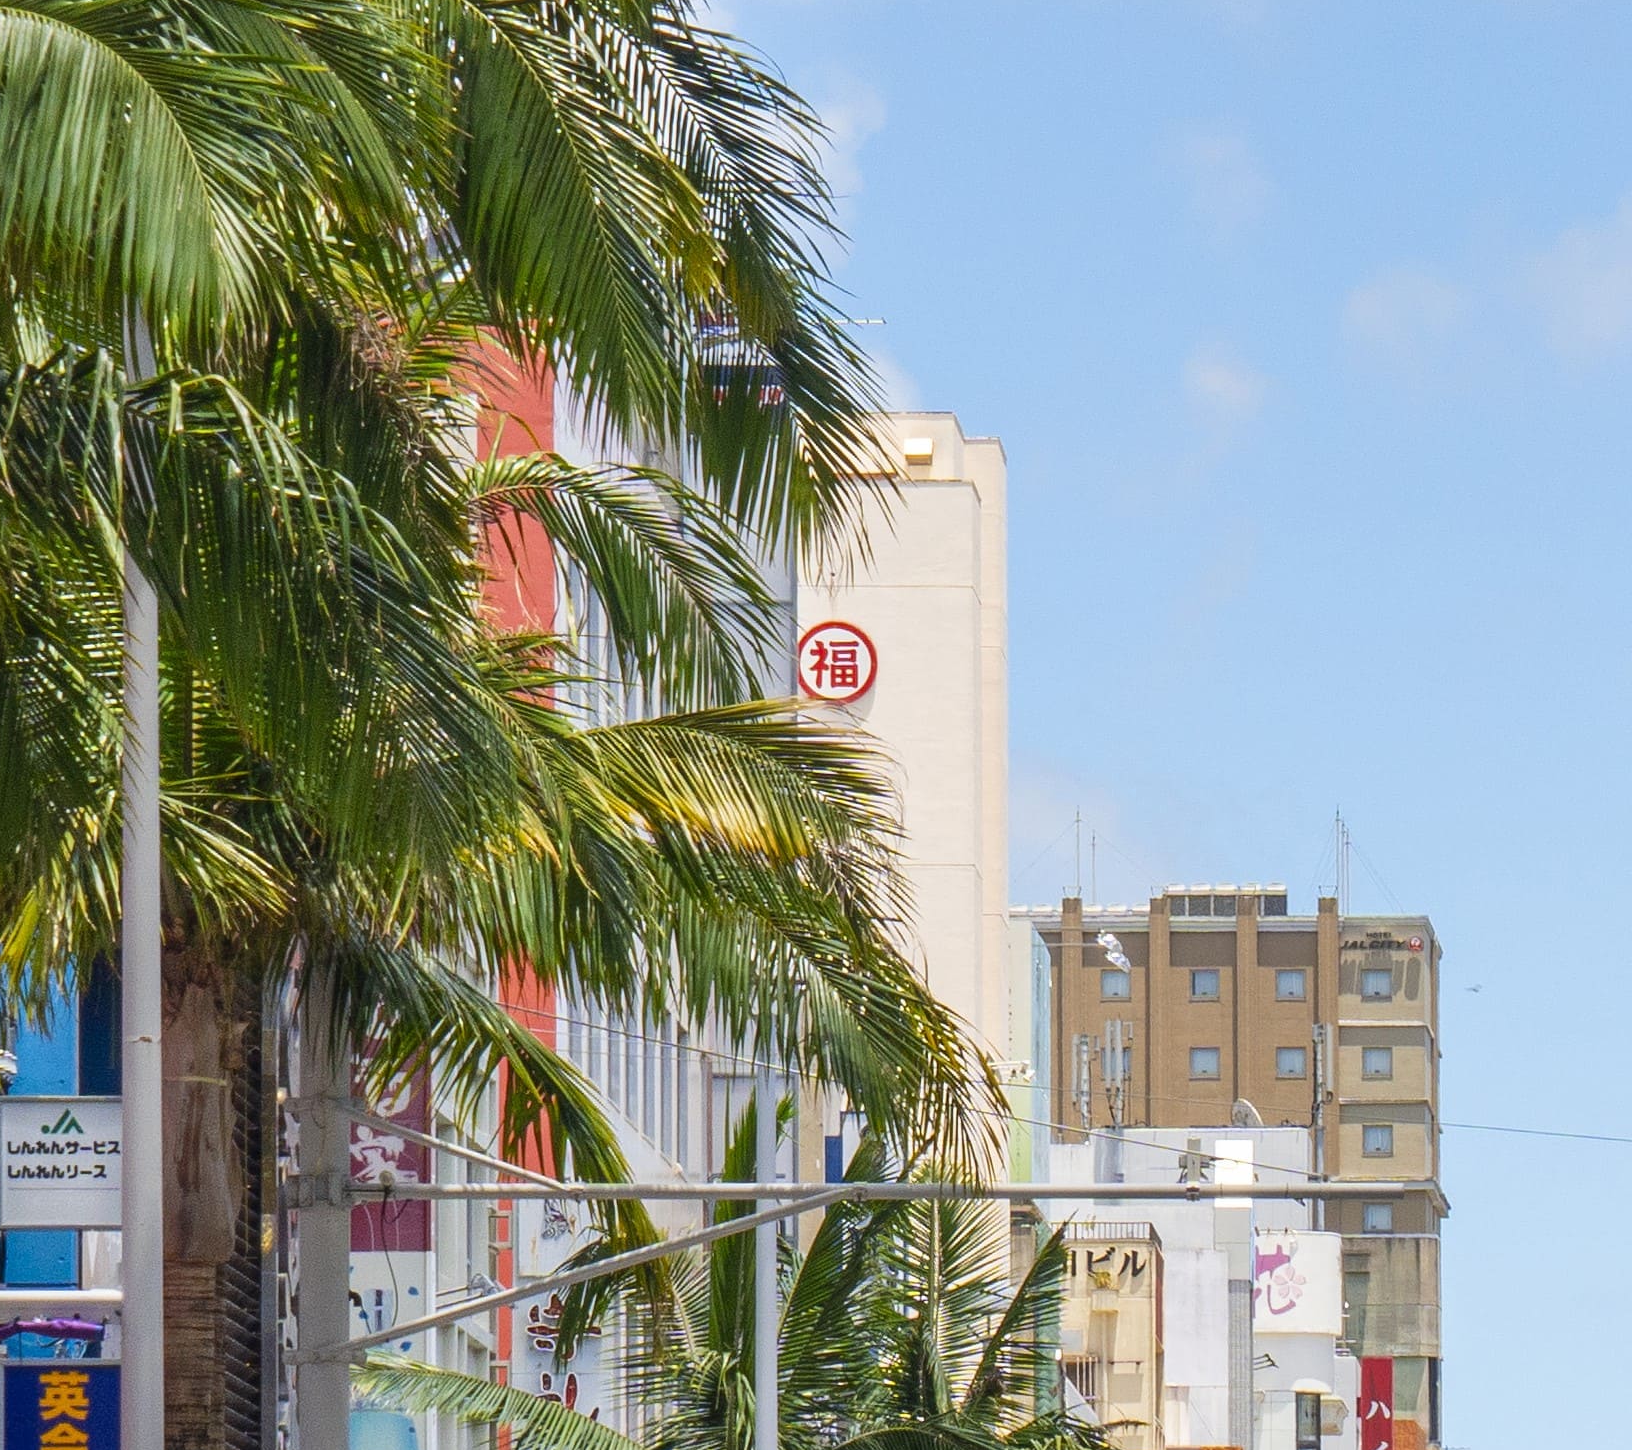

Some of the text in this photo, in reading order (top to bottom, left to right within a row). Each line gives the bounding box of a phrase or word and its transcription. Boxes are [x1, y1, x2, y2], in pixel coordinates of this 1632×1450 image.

[809, 640, 860, 688] 福
[1341, 940, 1406, 951] JALCITY
[7, 1140, 120, 1155] しんれんサービス
[7, 1164, 107, 1179] しんれんリース
